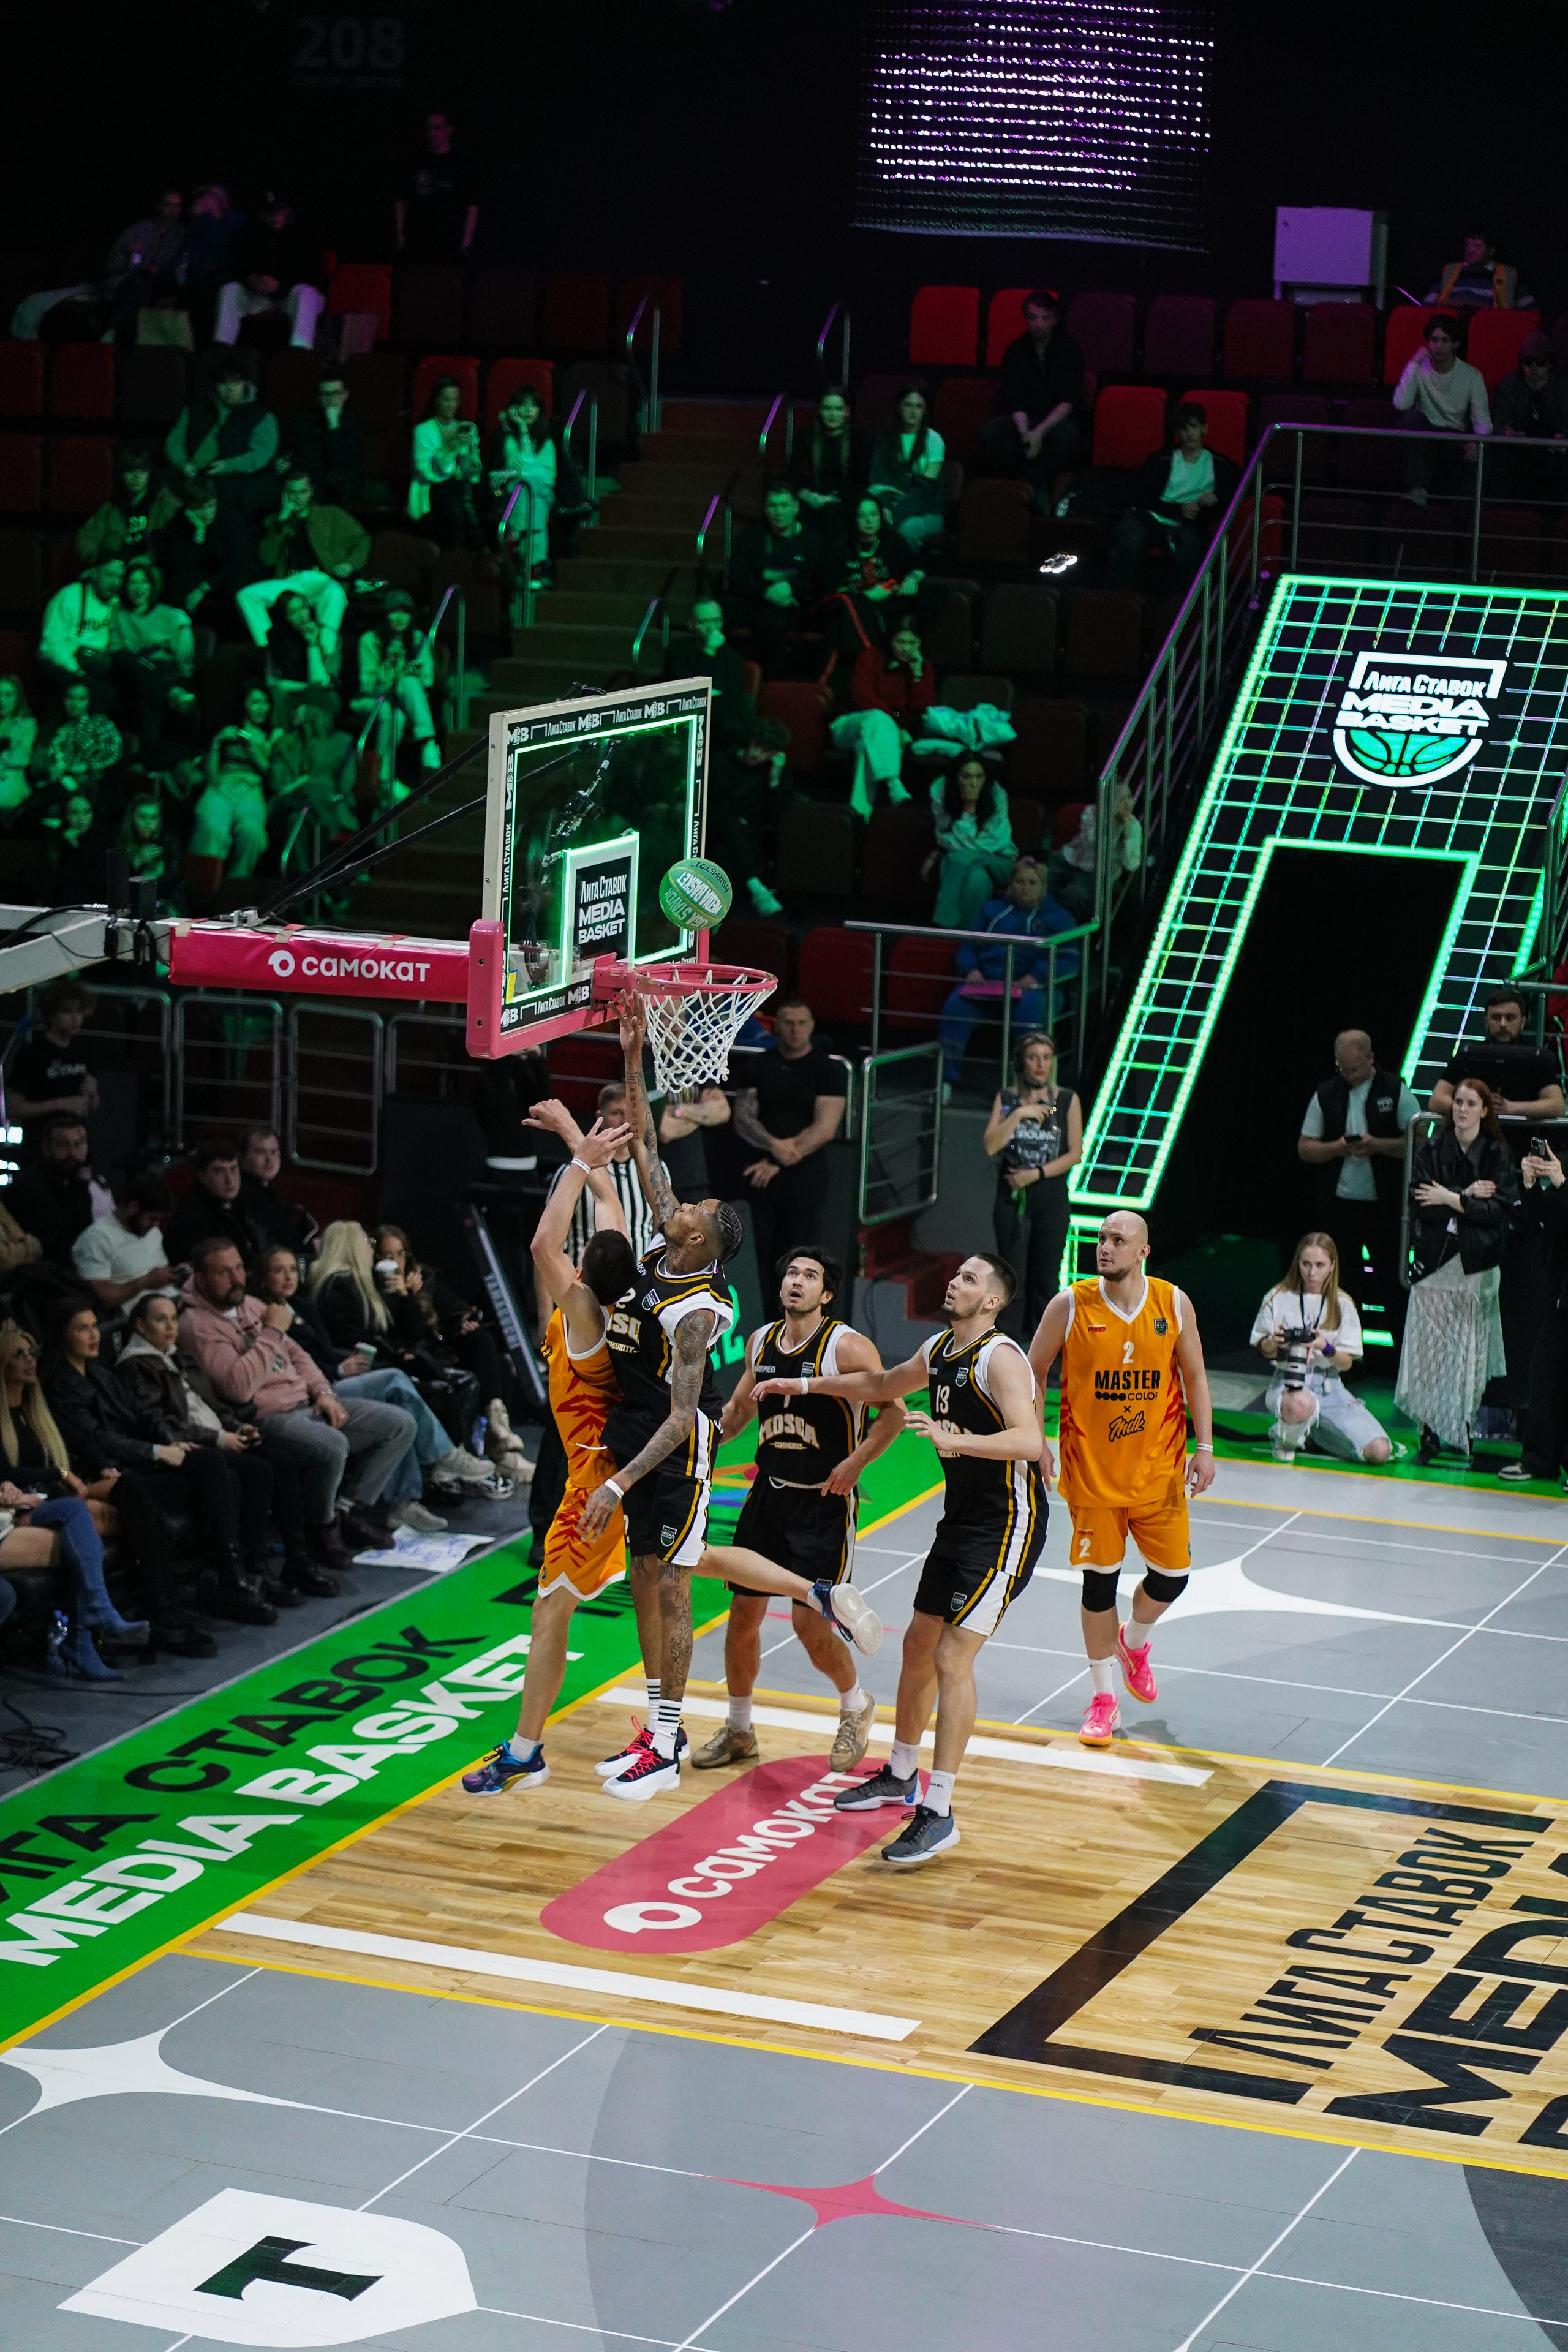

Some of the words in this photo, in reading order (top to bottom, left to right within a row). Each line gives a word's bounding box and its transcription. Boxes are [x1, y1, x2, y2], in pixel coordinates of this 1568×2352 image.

[292, 17, 405, 69] 208
[1363, 671, 1411, 693] ЛИГА
[1412, 674, 1487, 698] СТАВОК
[1340, 690, 1490, 720] MEDIA
[1335, 710, 1489, 736] BASKET
[580, 880, 599, 903] ЛИГА
[599, 874, 627, 899] СТАВОК
[676, 872, 709, 902] BASKET
[699, 888, 723, 915] MEDIA
[579, 898, 625, 927] MEDIA
[578, 918, 625, 945] BASKET
[1122, 1341, 1135, 1364] 2
[1095, 1370, 1161, 1390] MASTER
[936, 1384, 951, 1414] 13
[759, 1413, 821, 1449] MOSCA
[1079, 1537, 1091, 1558] 2
[124, 1626, 488, 1792] СТАВОК
[0, 1814, 304, 1967] MEDIA
[234, 1634, 584, 1806] BASKET
[1285, 1827, 1535, 1964] СТАВОК
[1188, 1965, 1412, 2070] ЛИГА
